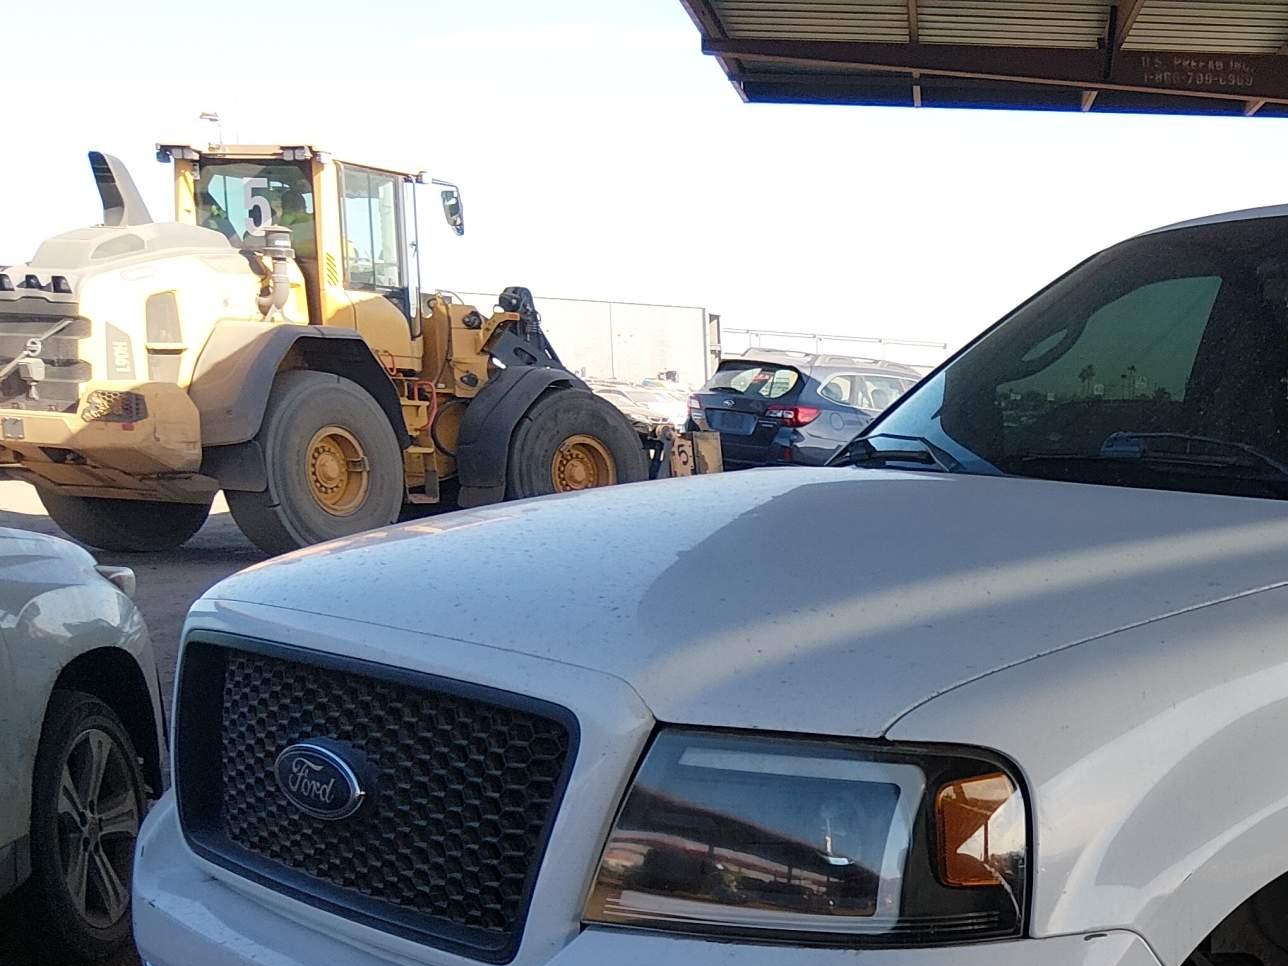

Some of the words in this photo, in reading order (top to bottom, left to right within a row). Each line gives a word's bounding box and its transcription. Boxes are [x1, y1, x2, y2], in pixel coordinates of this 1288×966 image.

[244, 177, 272, 237] 5
[677, 443, 689, 466] 5
[288, 757, 336, 804] Ford
